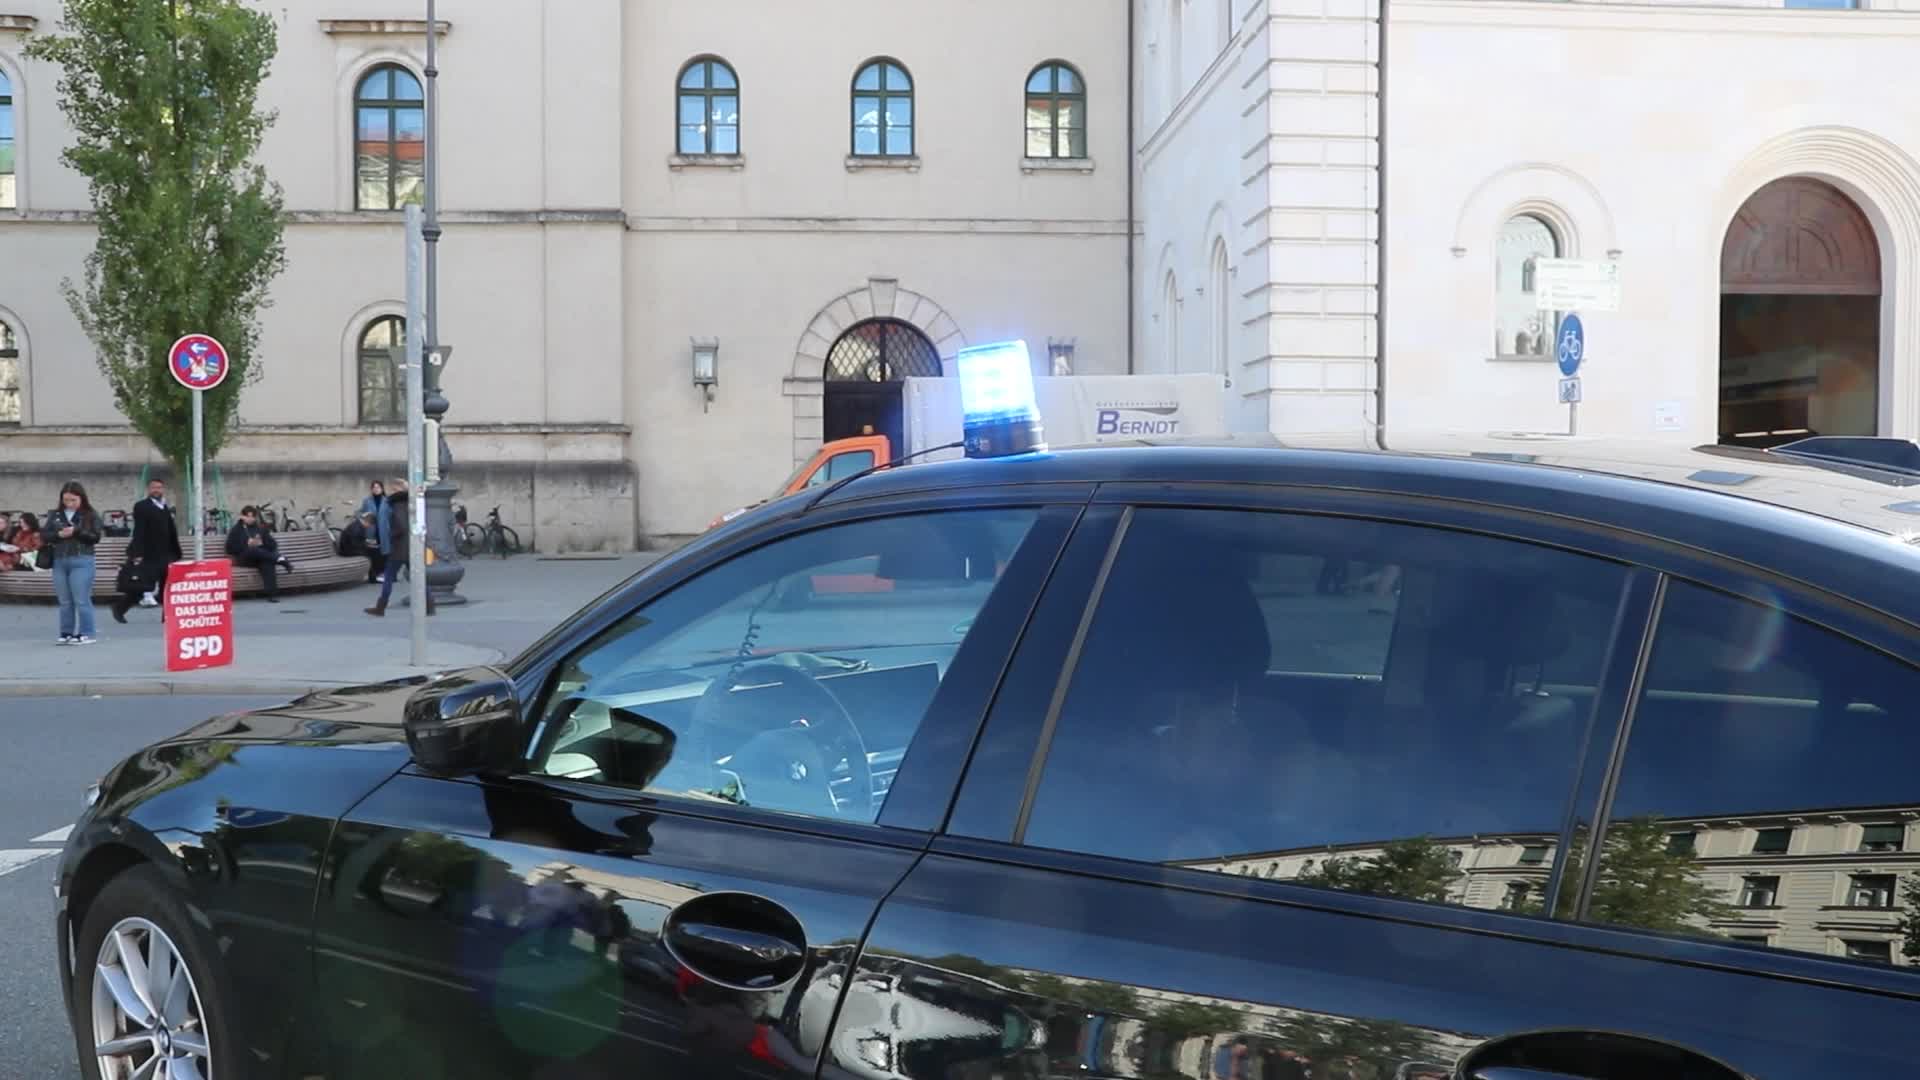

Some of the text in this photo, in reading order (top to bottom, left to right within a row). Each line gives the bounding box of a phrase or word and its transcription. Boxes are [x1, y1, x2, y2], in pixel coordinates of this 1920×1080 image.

[1097, 410, 1179, 434] BERNDT
[170, 579, 228, 592] BEZAHLBARE
[214, 591, 228, 601] DIE
[175, 603, 224, 617] DAS KLIMA
[179, 635, 223, 660] SPD
